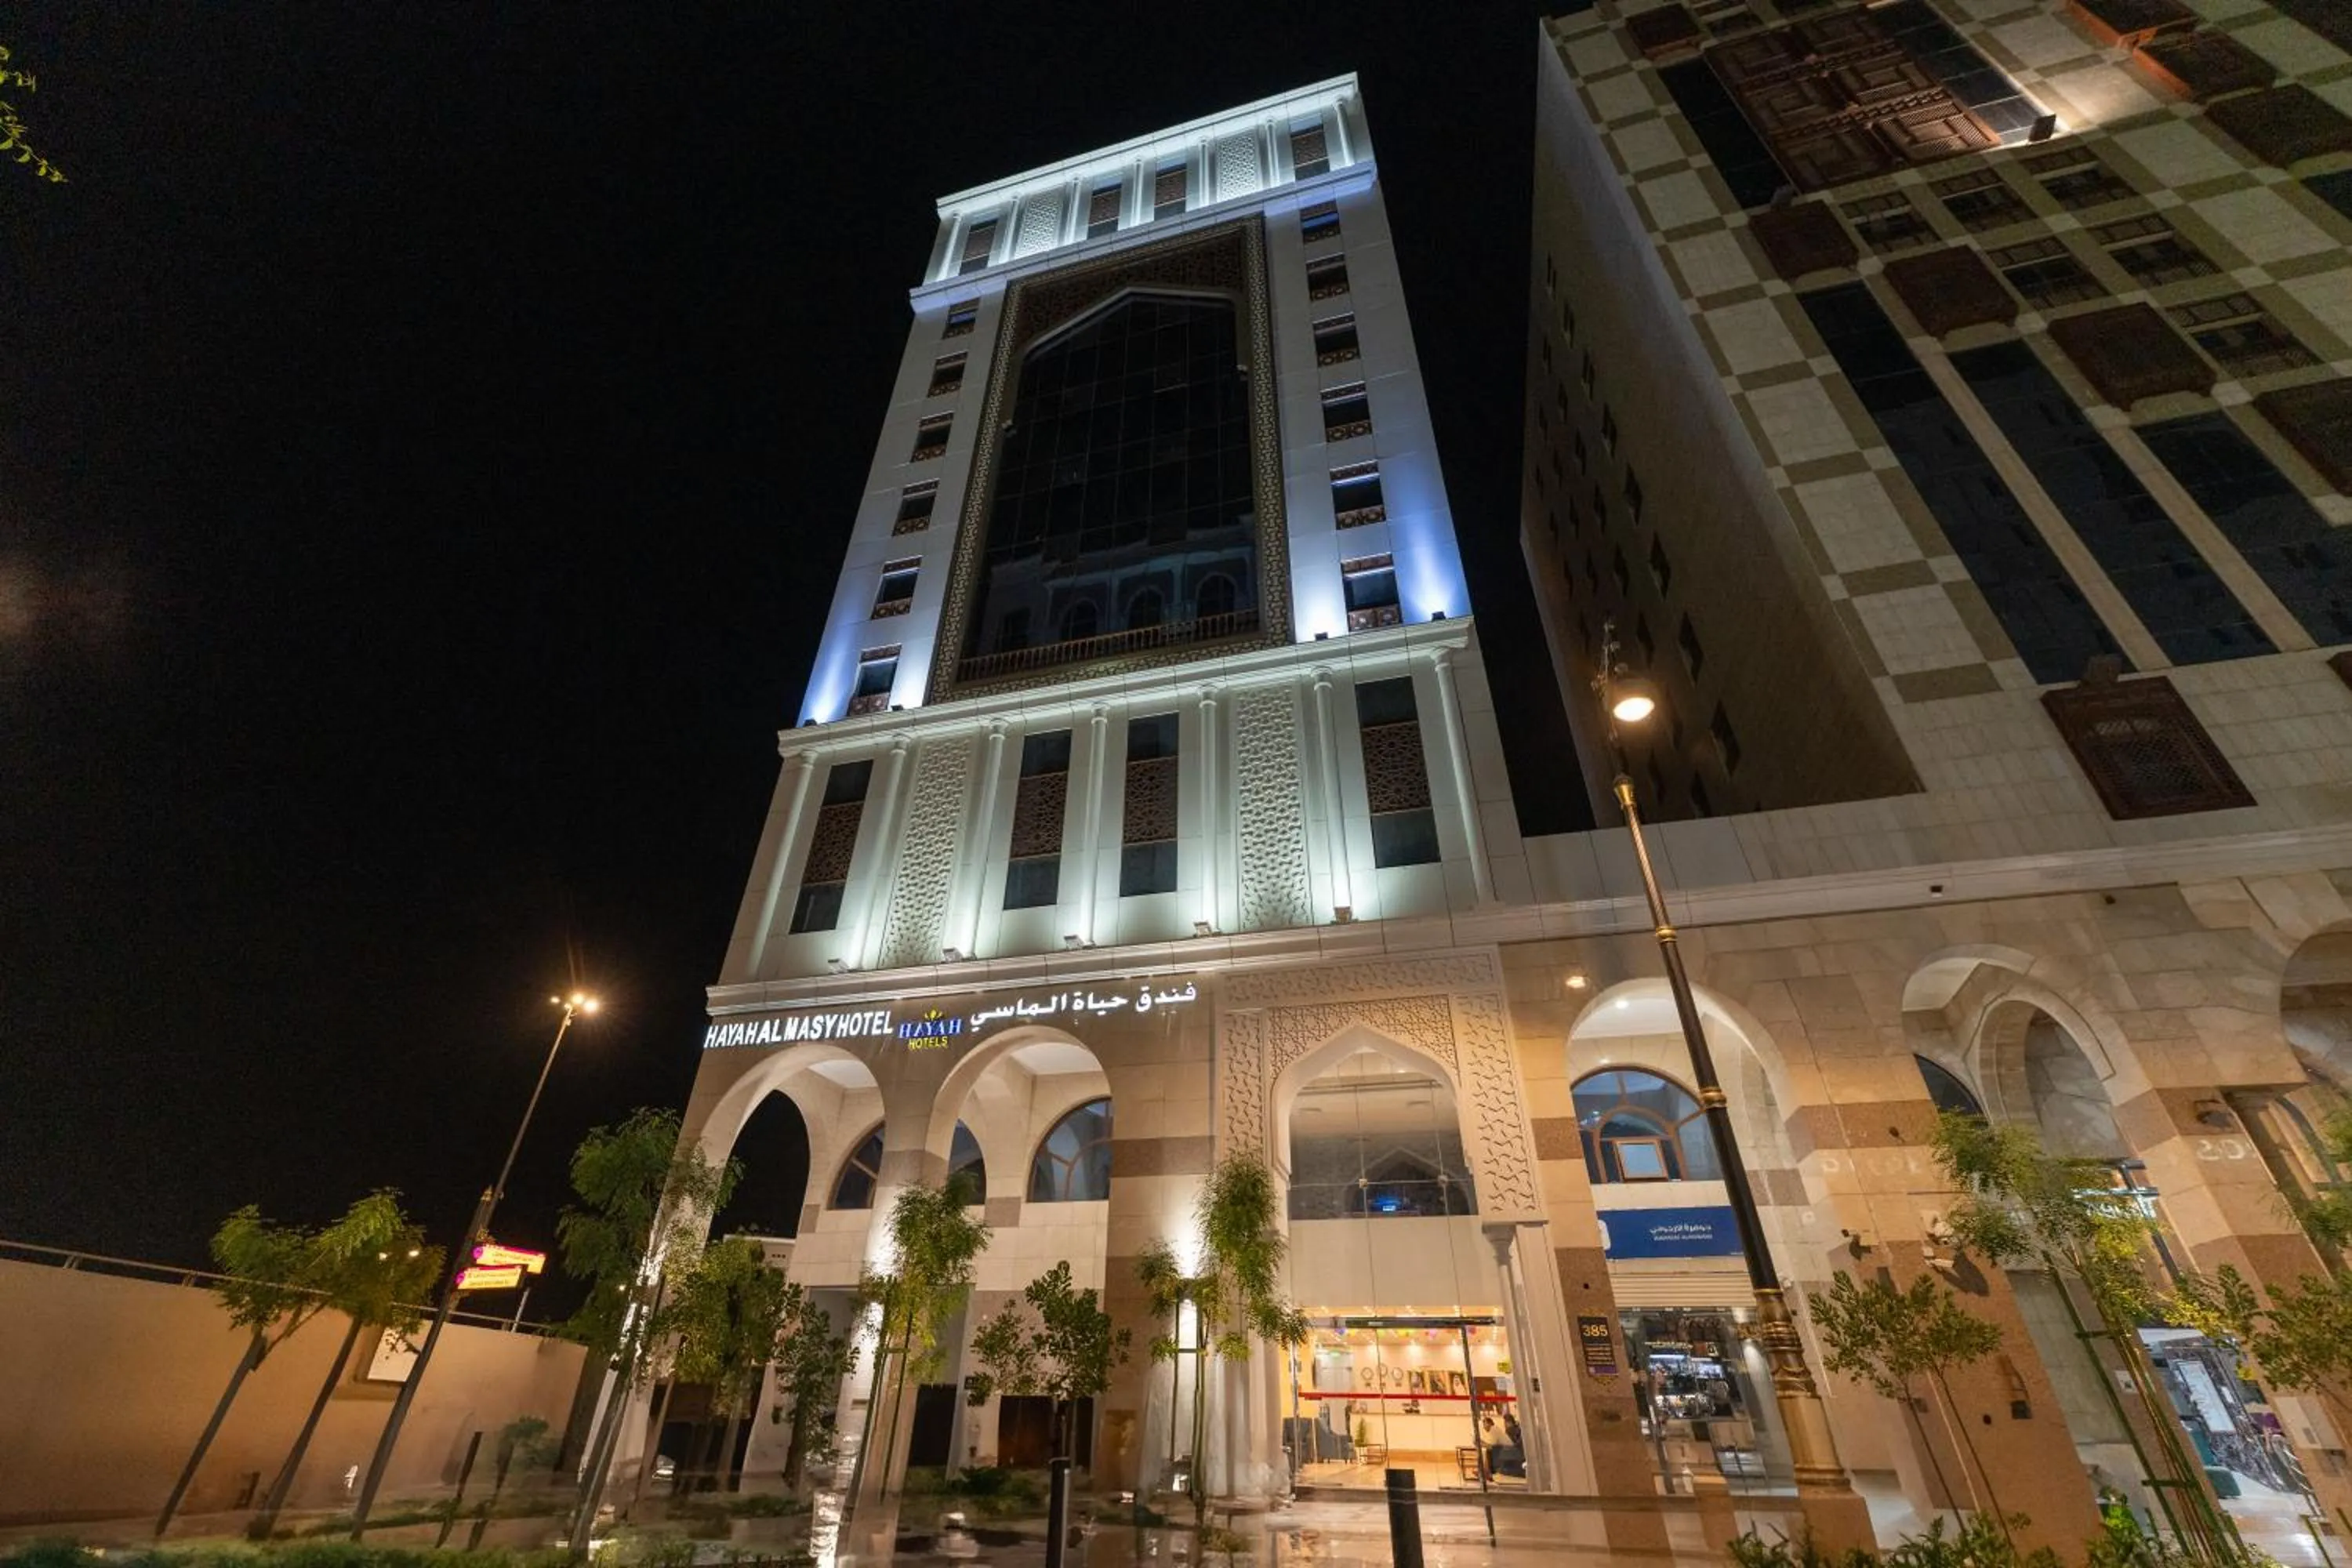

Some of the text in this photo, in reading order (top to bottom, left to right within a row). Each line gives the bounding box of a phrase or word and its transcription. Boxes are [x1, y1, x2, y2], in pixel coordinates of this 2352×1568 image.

[971, 981, 1196, 1032] فندق حياة الماسي
[898, 1018, 962, 1039] HAYAH
[908, 1036, 948, 1050] HOTELS
[1582, 1324, 1609, 1337] 385
